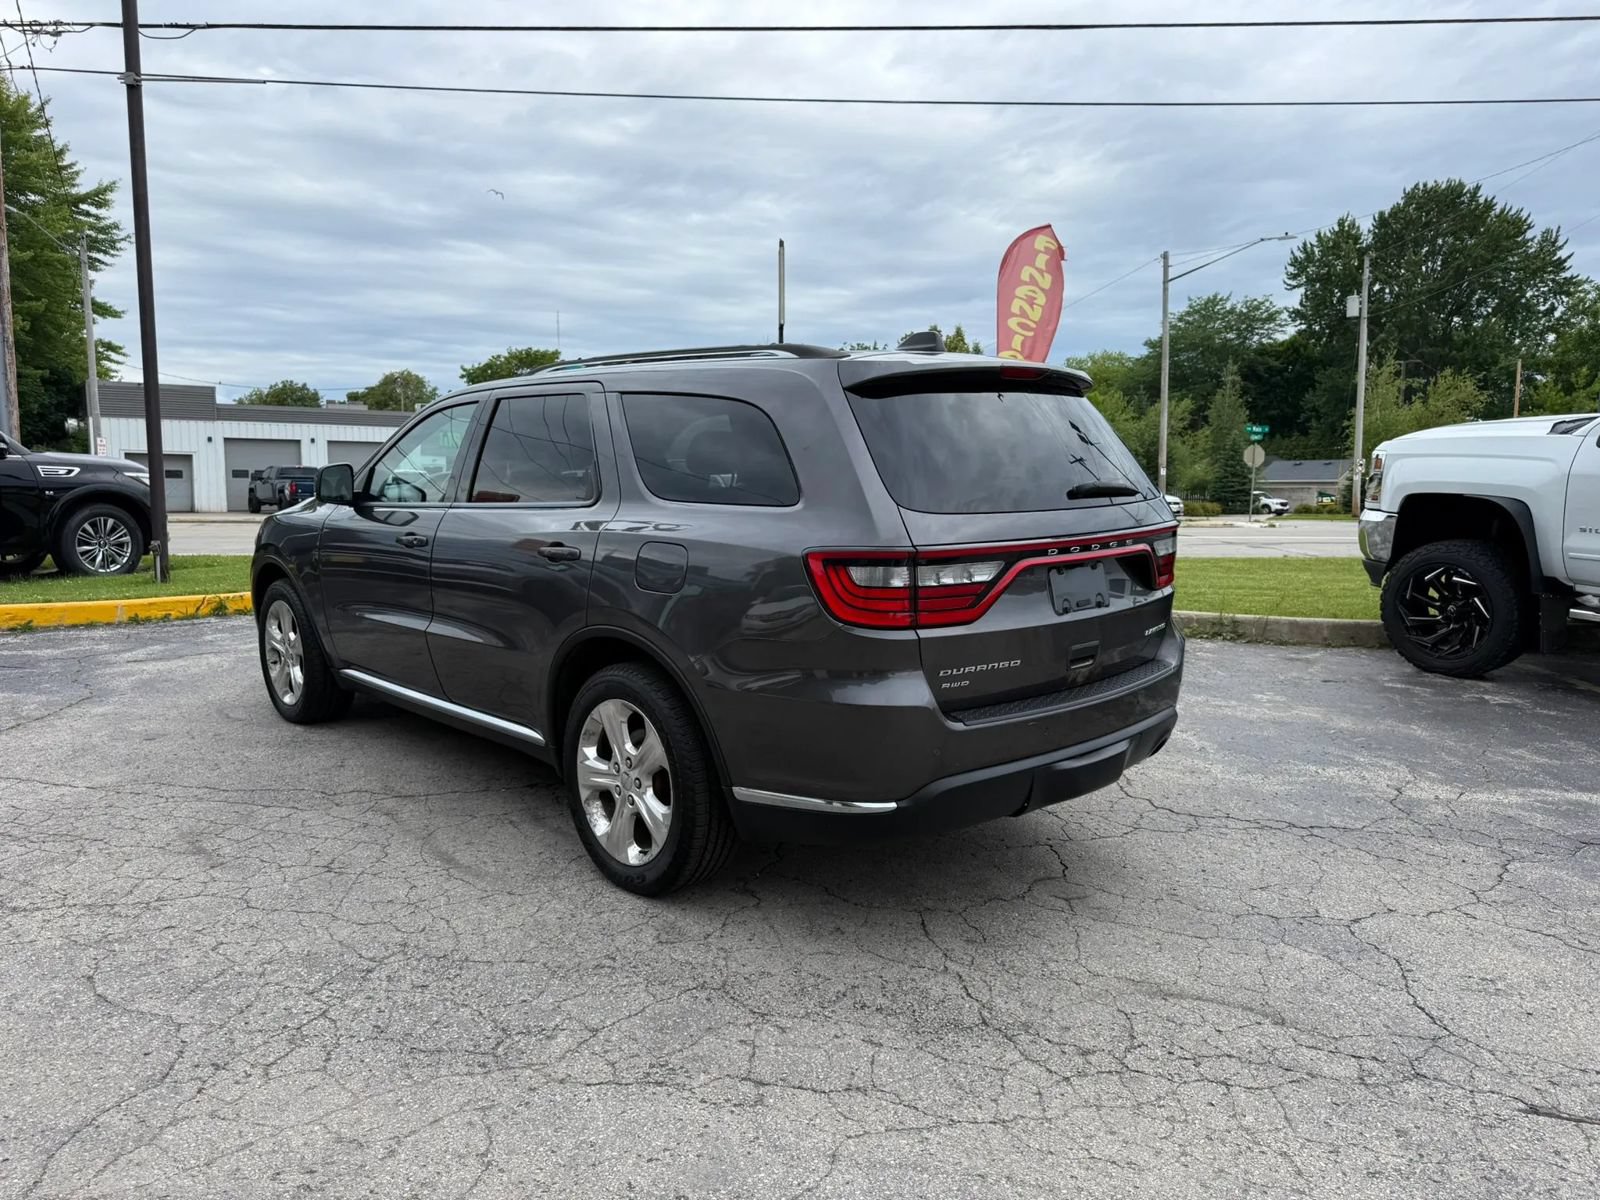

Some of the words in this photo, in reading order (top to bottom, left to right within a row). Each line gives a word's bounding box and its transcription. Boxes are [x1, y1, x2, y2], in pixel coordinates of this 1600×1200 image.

[1048, 539, 1133, 556] DODGE
[939, 660, 1021, 677] DURANGO
[941, 680, 970, 689] AWD
